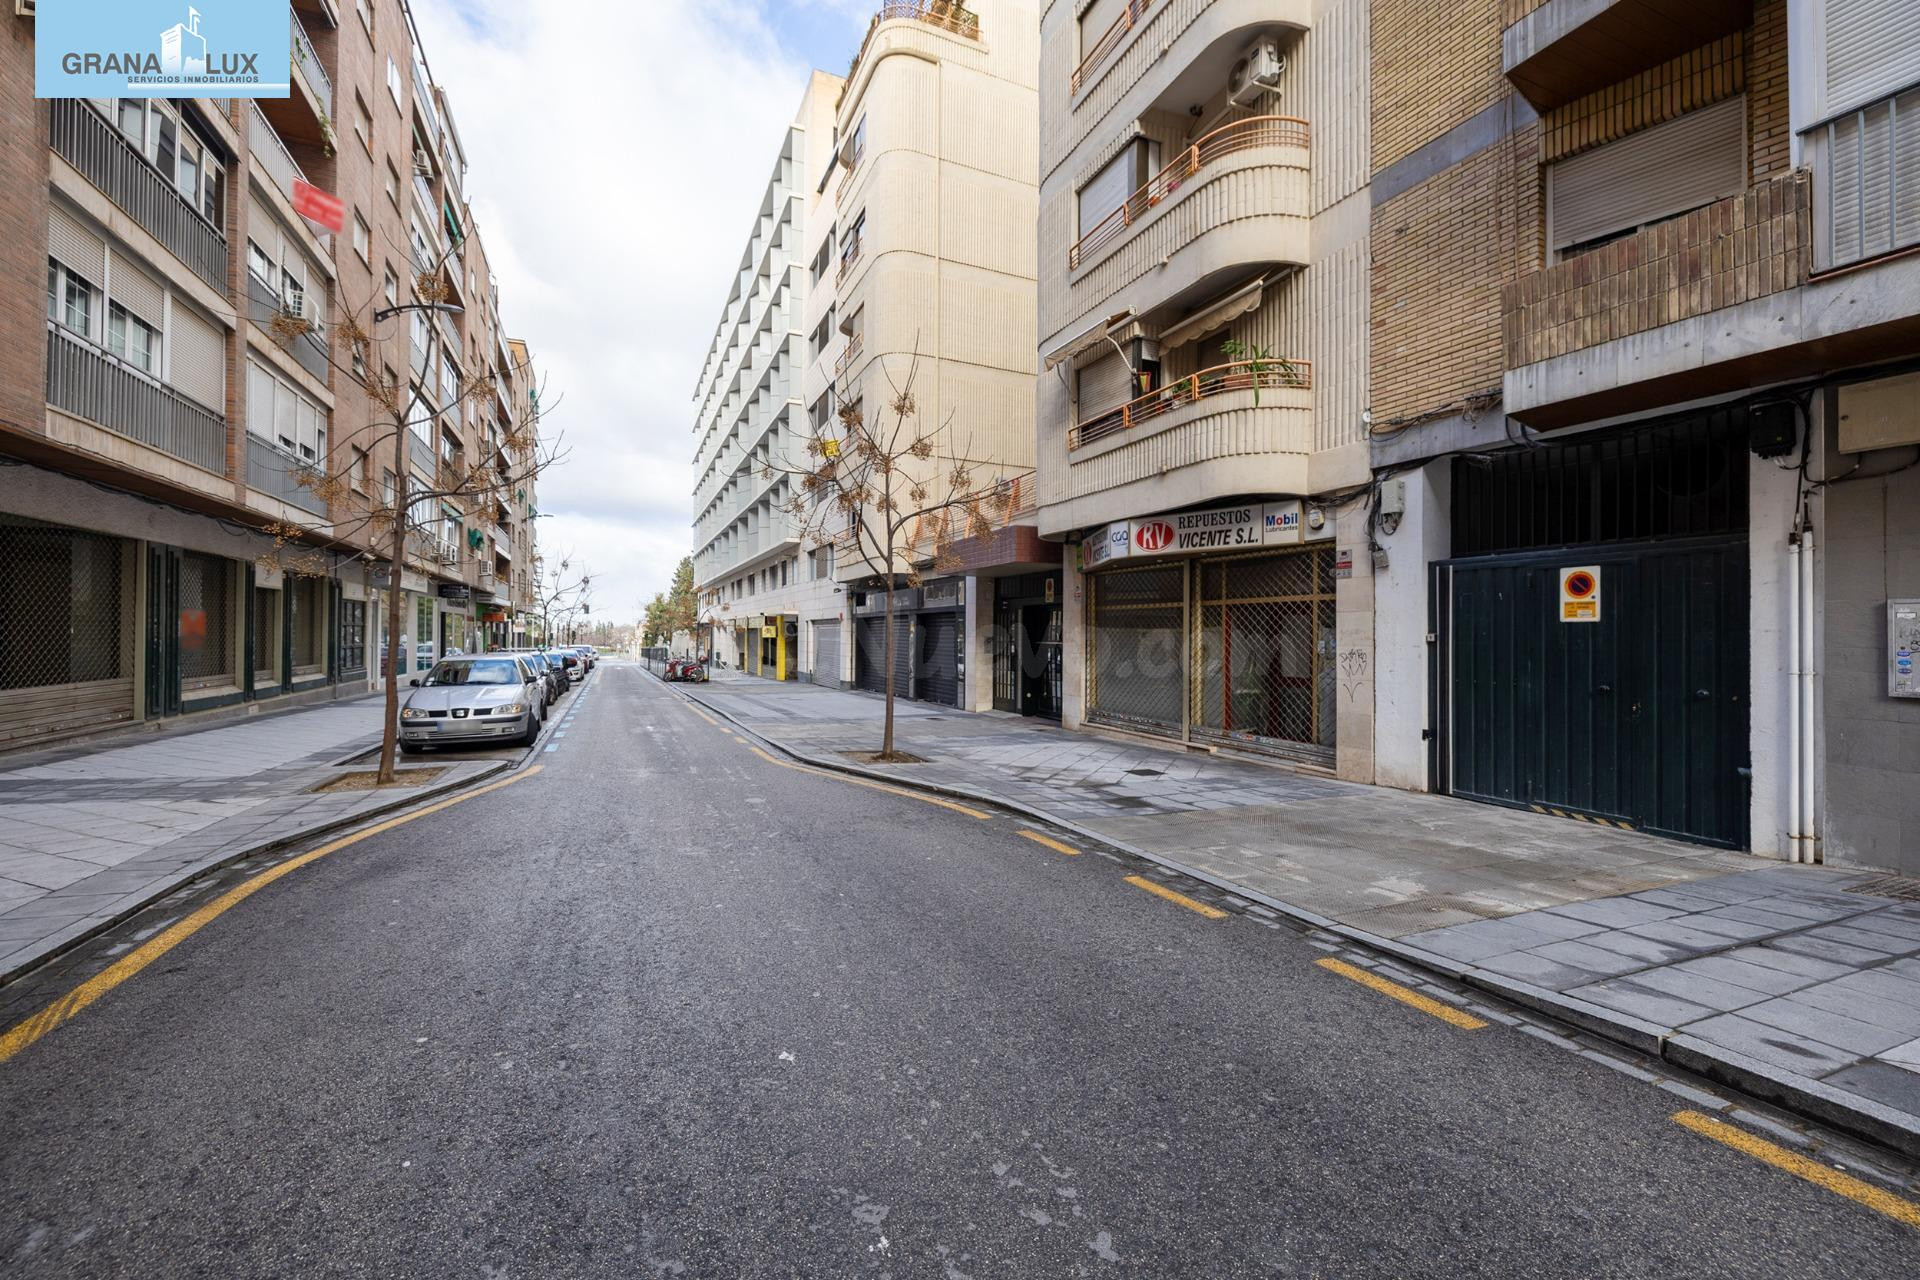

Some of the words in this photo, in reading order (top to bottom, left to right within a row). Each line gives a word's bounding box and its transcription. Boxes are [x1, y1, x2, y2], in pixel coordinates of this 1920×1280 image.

[1178, 508, 1251, 529] REPUESTOS
[1265, 512, 1298, 527] Mobil
[1178, 528, 1232, 549] VICENTE
[1235, 526, 1259, 544] S.L.
